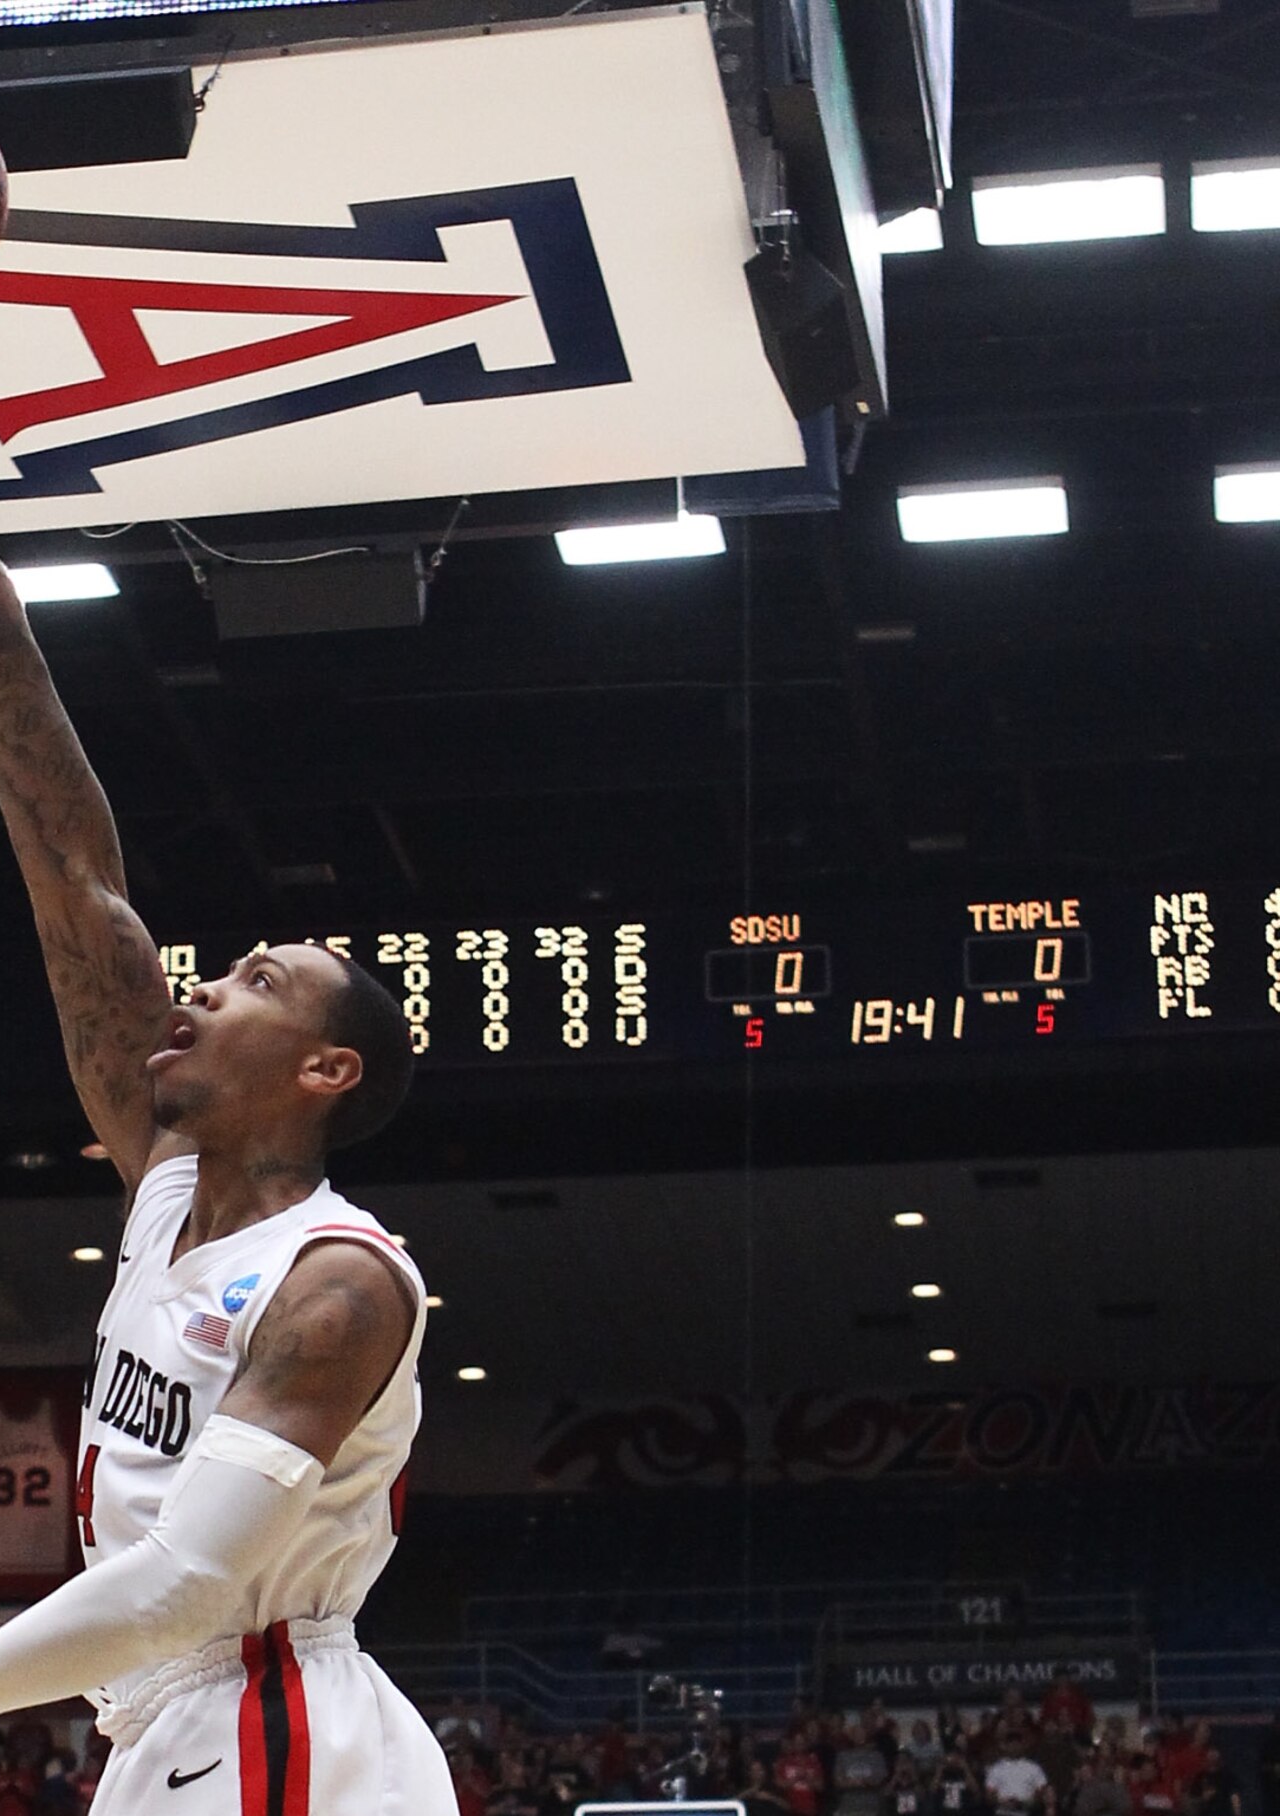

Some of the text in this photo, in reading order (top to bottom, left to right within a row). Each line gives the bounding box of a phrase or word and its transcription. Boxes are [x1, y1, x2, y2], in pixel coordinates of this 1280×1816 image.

[730, 915, 801, 944] SDSU
[967, 899, 1081, 932] TEMPLE
[534, 926, 588, 958] 32
[403, 963, 431, 993] 0
[482, 960, 510, 990] 0
[561, 957, 589, 987] 0
[774, 952, 803, 994] 0
[1034, 938, 1062, 982] 0
[403, 987, 589, 1024] 0 0 0
[1035, 1003, 1055, 1034] 5
[482, 1020, 510, 1051] 0
[562, 1018, 589, 1048] 0
[745, 1018, 764, 1048] 5
[98, 1348, 192, 1457] DIEGO
[958, 1596, 1003, 1624] 121
[855, 1665, 919, 1688] HALL
[926, 1664, 958, 1686] OF
